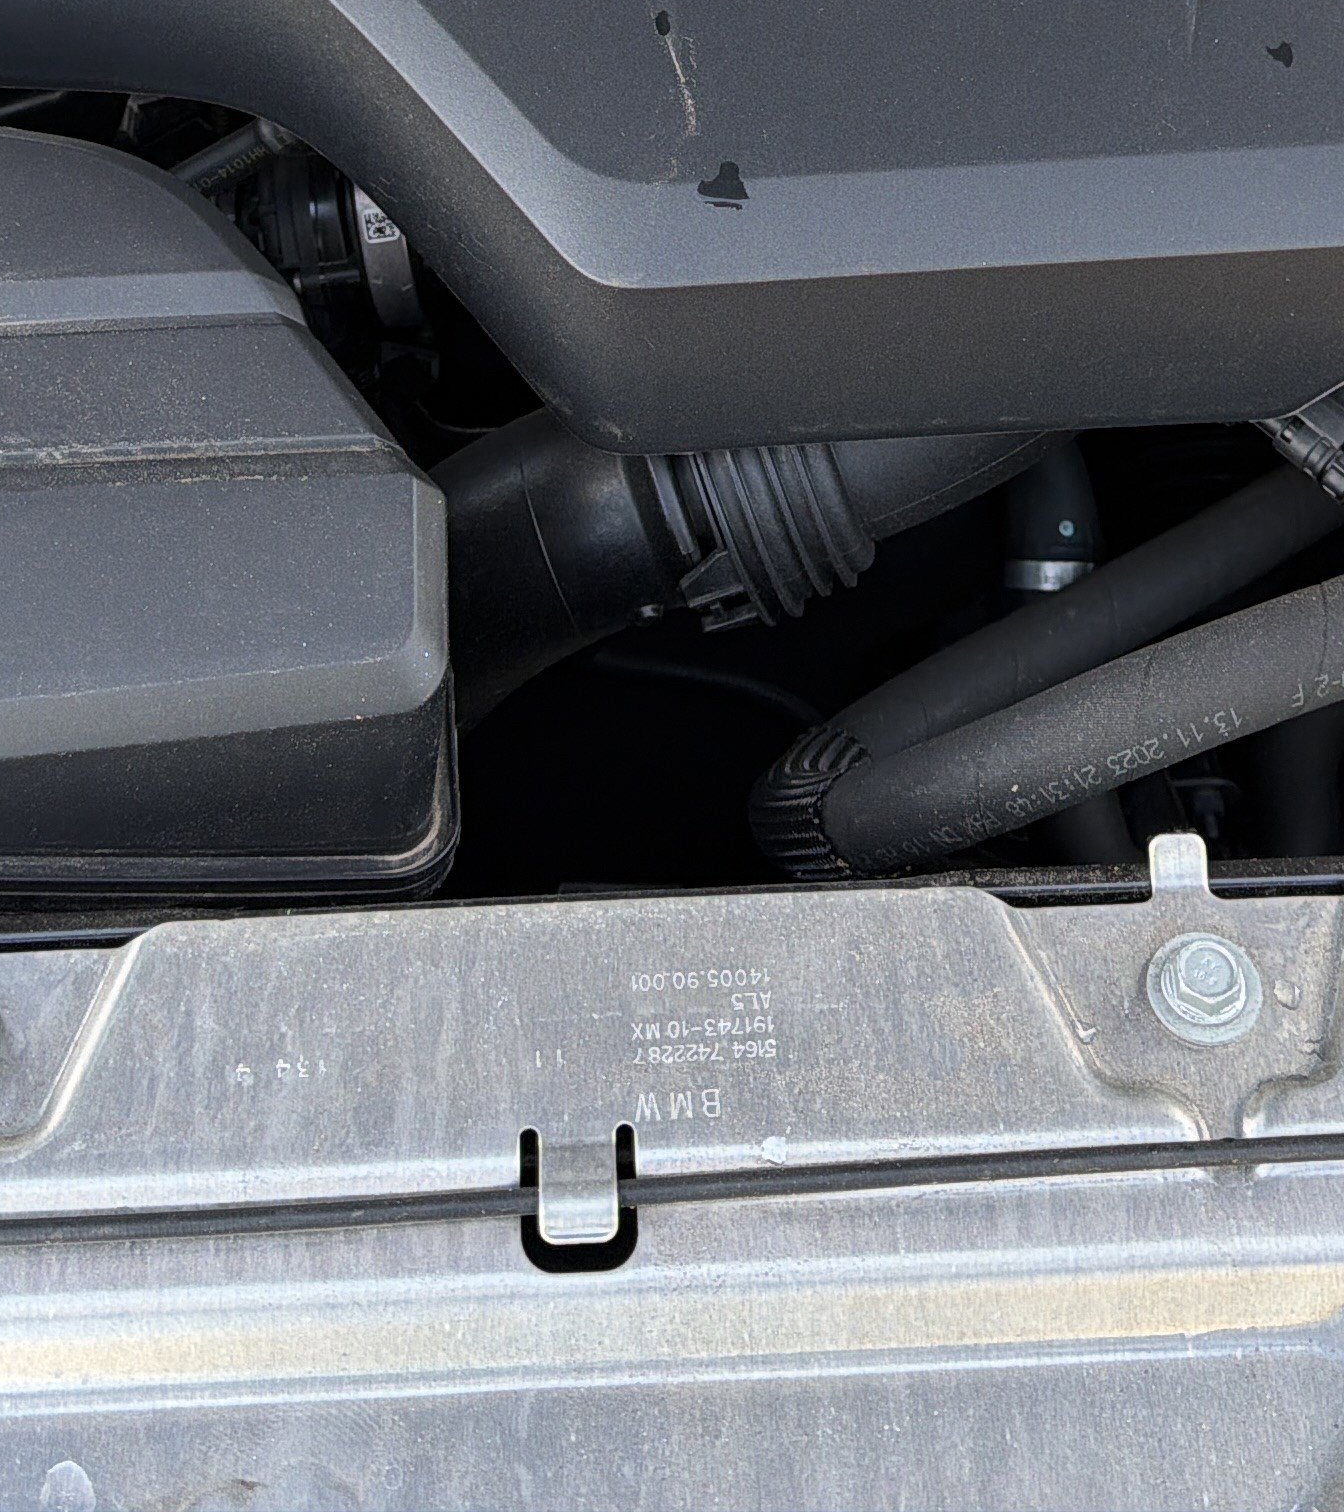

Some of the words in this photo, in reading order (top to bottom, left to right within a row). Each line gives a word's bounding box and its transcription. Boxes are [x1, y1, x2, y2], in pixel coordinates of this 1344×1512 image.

[1106, 706, 1244, 777] 13.11.2023
[730, 990, 772, 1011] AL5
[630, 1021, 661, 1040] MX
[667, 1015, 776, 1037] 191743-10
[633, 1042, 723, 1065] 7422287
[732, 1038, 777, 1059] 5164
